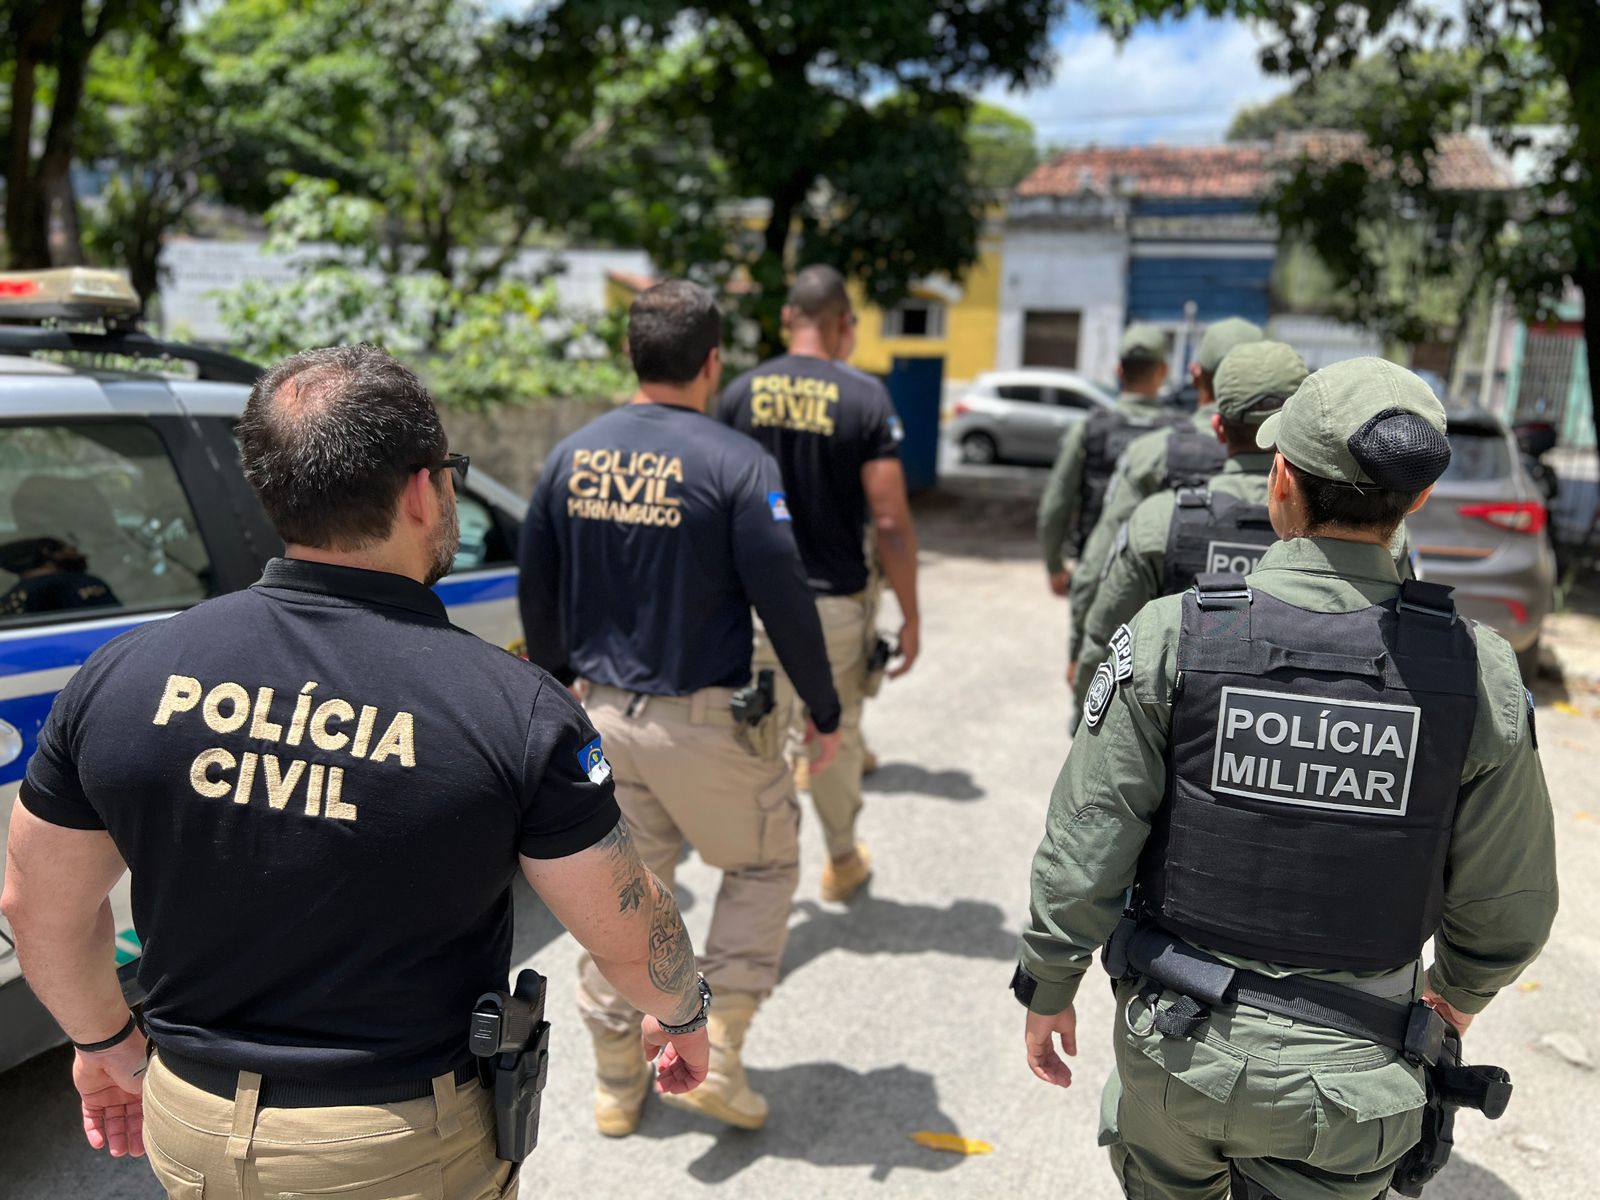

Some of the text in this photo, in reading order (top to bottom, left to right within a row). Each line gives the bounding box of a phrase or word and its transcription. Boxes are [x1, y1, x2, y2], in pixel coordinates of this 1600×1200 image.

[751, 393, 834, 426] CIVIL
[568, 470, 681, 506] CIVIL
[152, 674, 416, 767] POLÍCIA
[1225, 707, 1405, 759] POLÍCIA
[189, 747, 357, 821] CIVIL
[1221, 751, 1396, 803] MILITAR
